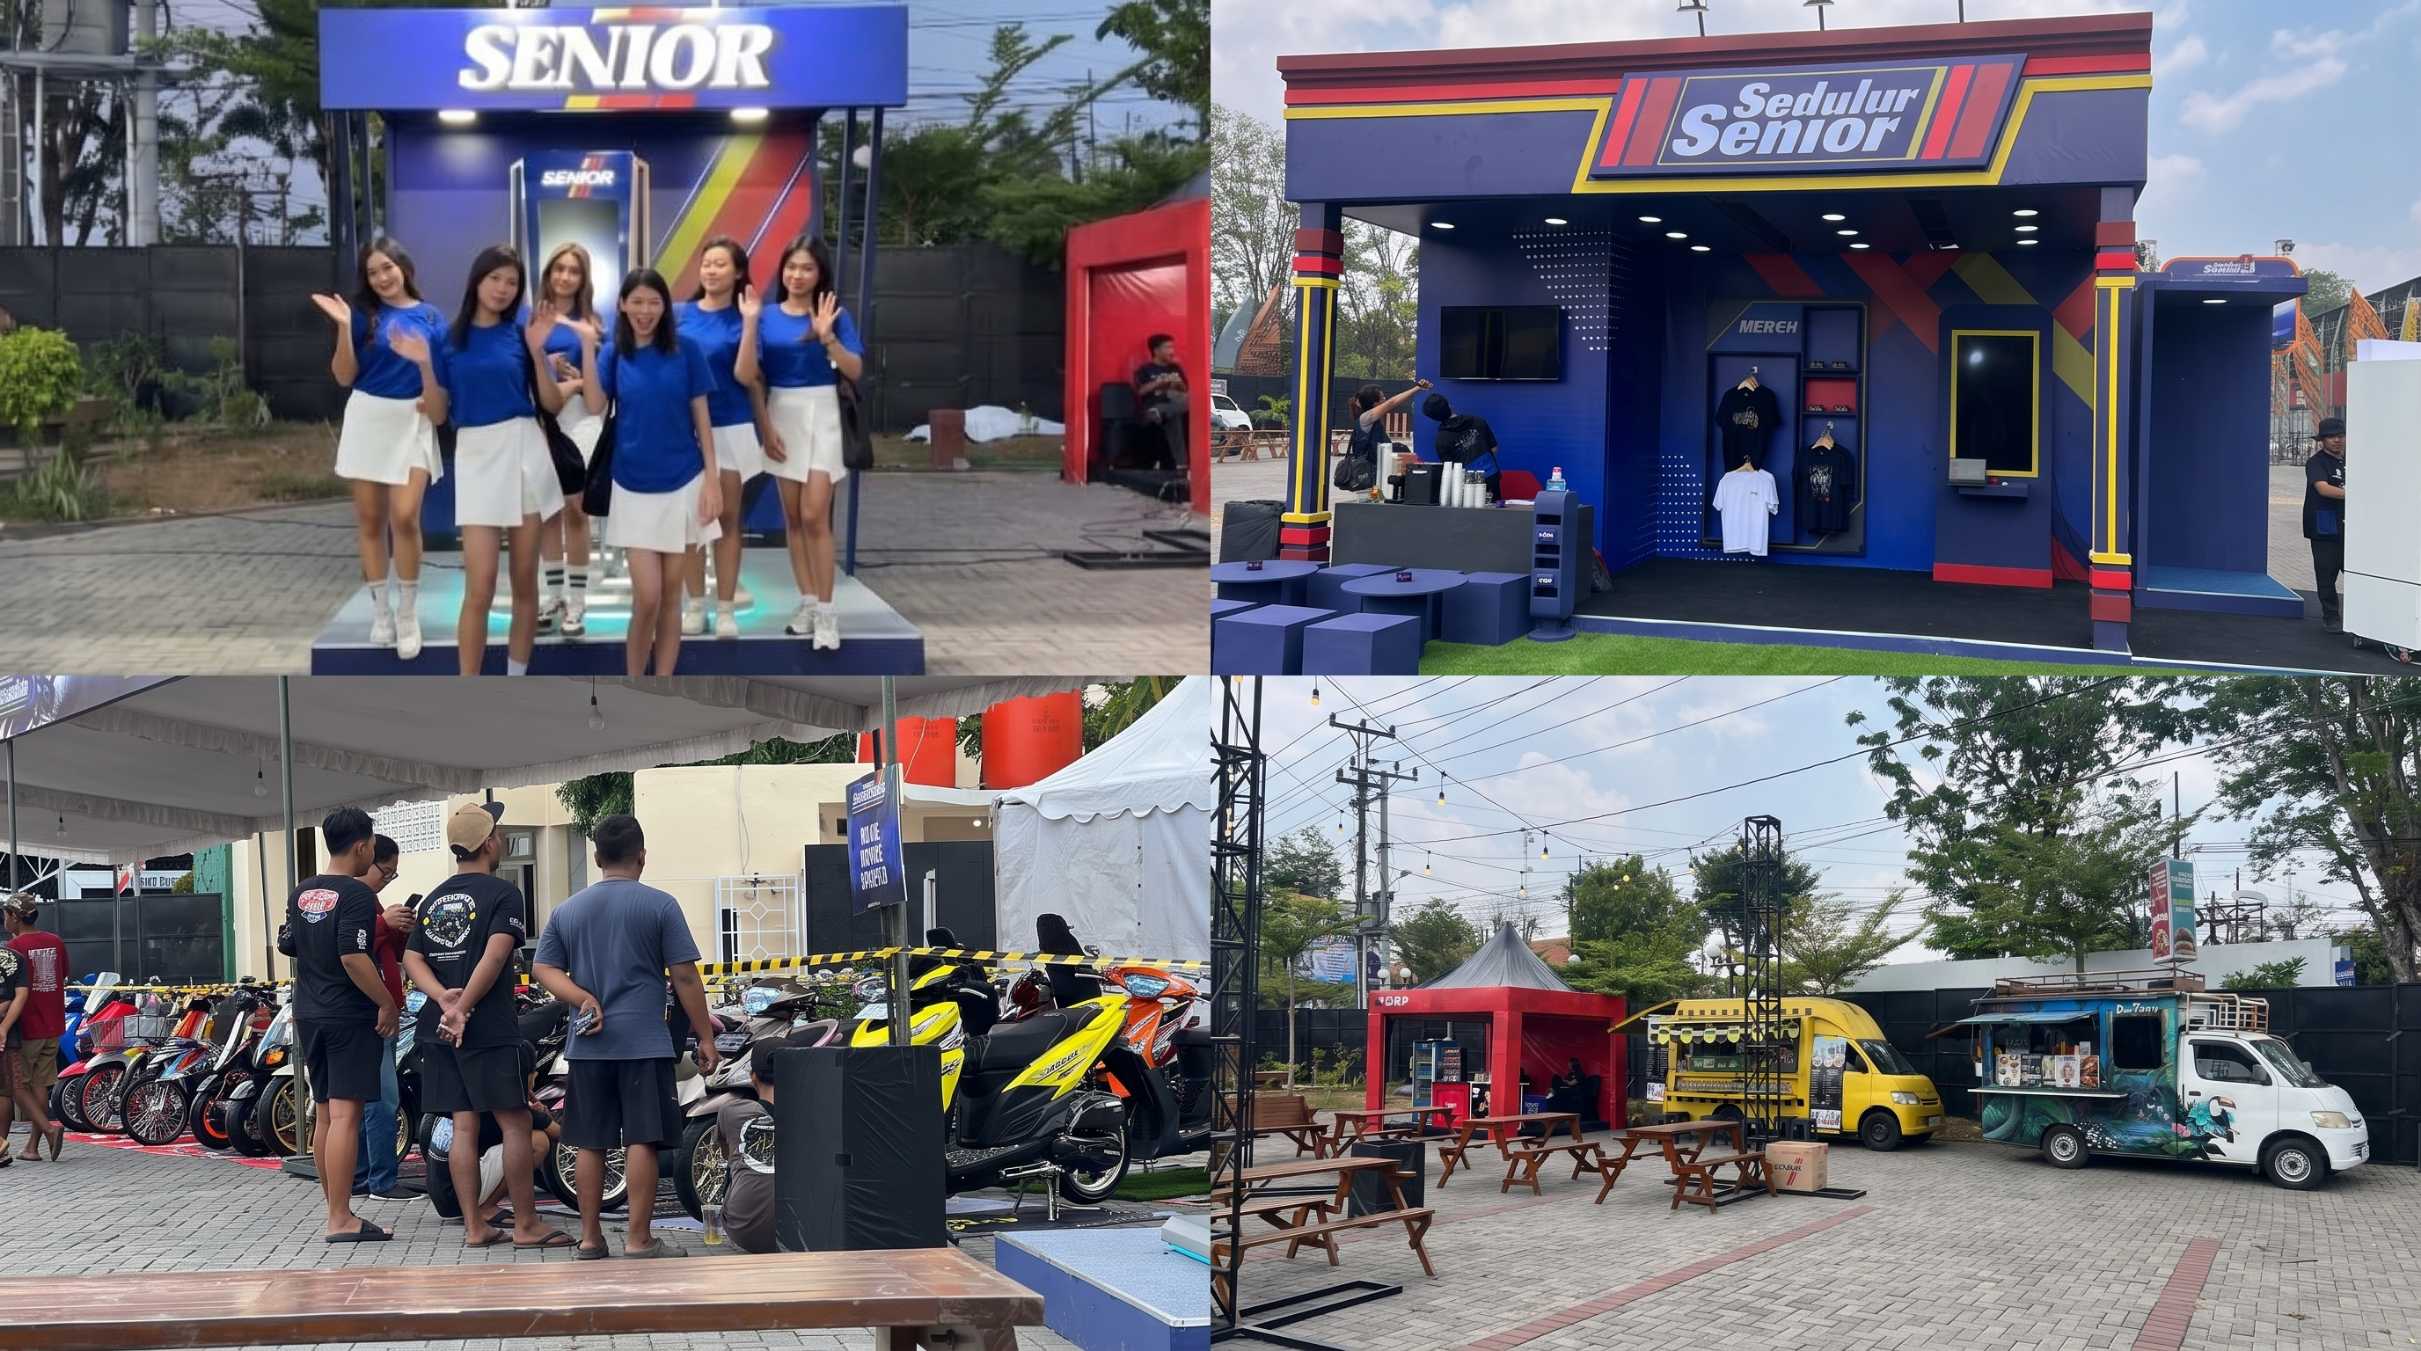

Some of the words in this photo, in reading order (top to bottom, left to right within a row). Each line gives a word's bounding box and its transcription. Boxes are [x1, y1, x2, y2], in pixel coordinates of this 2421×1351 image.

[457, 23, 774, 91] SENIOR
[1732, 78, 1920, 119] Sedulur
[1671, 103, 1902, 158] Senior
[540, 169, 616, 188] SENIOR
[1738, 319, 1799, 334] MERCH
